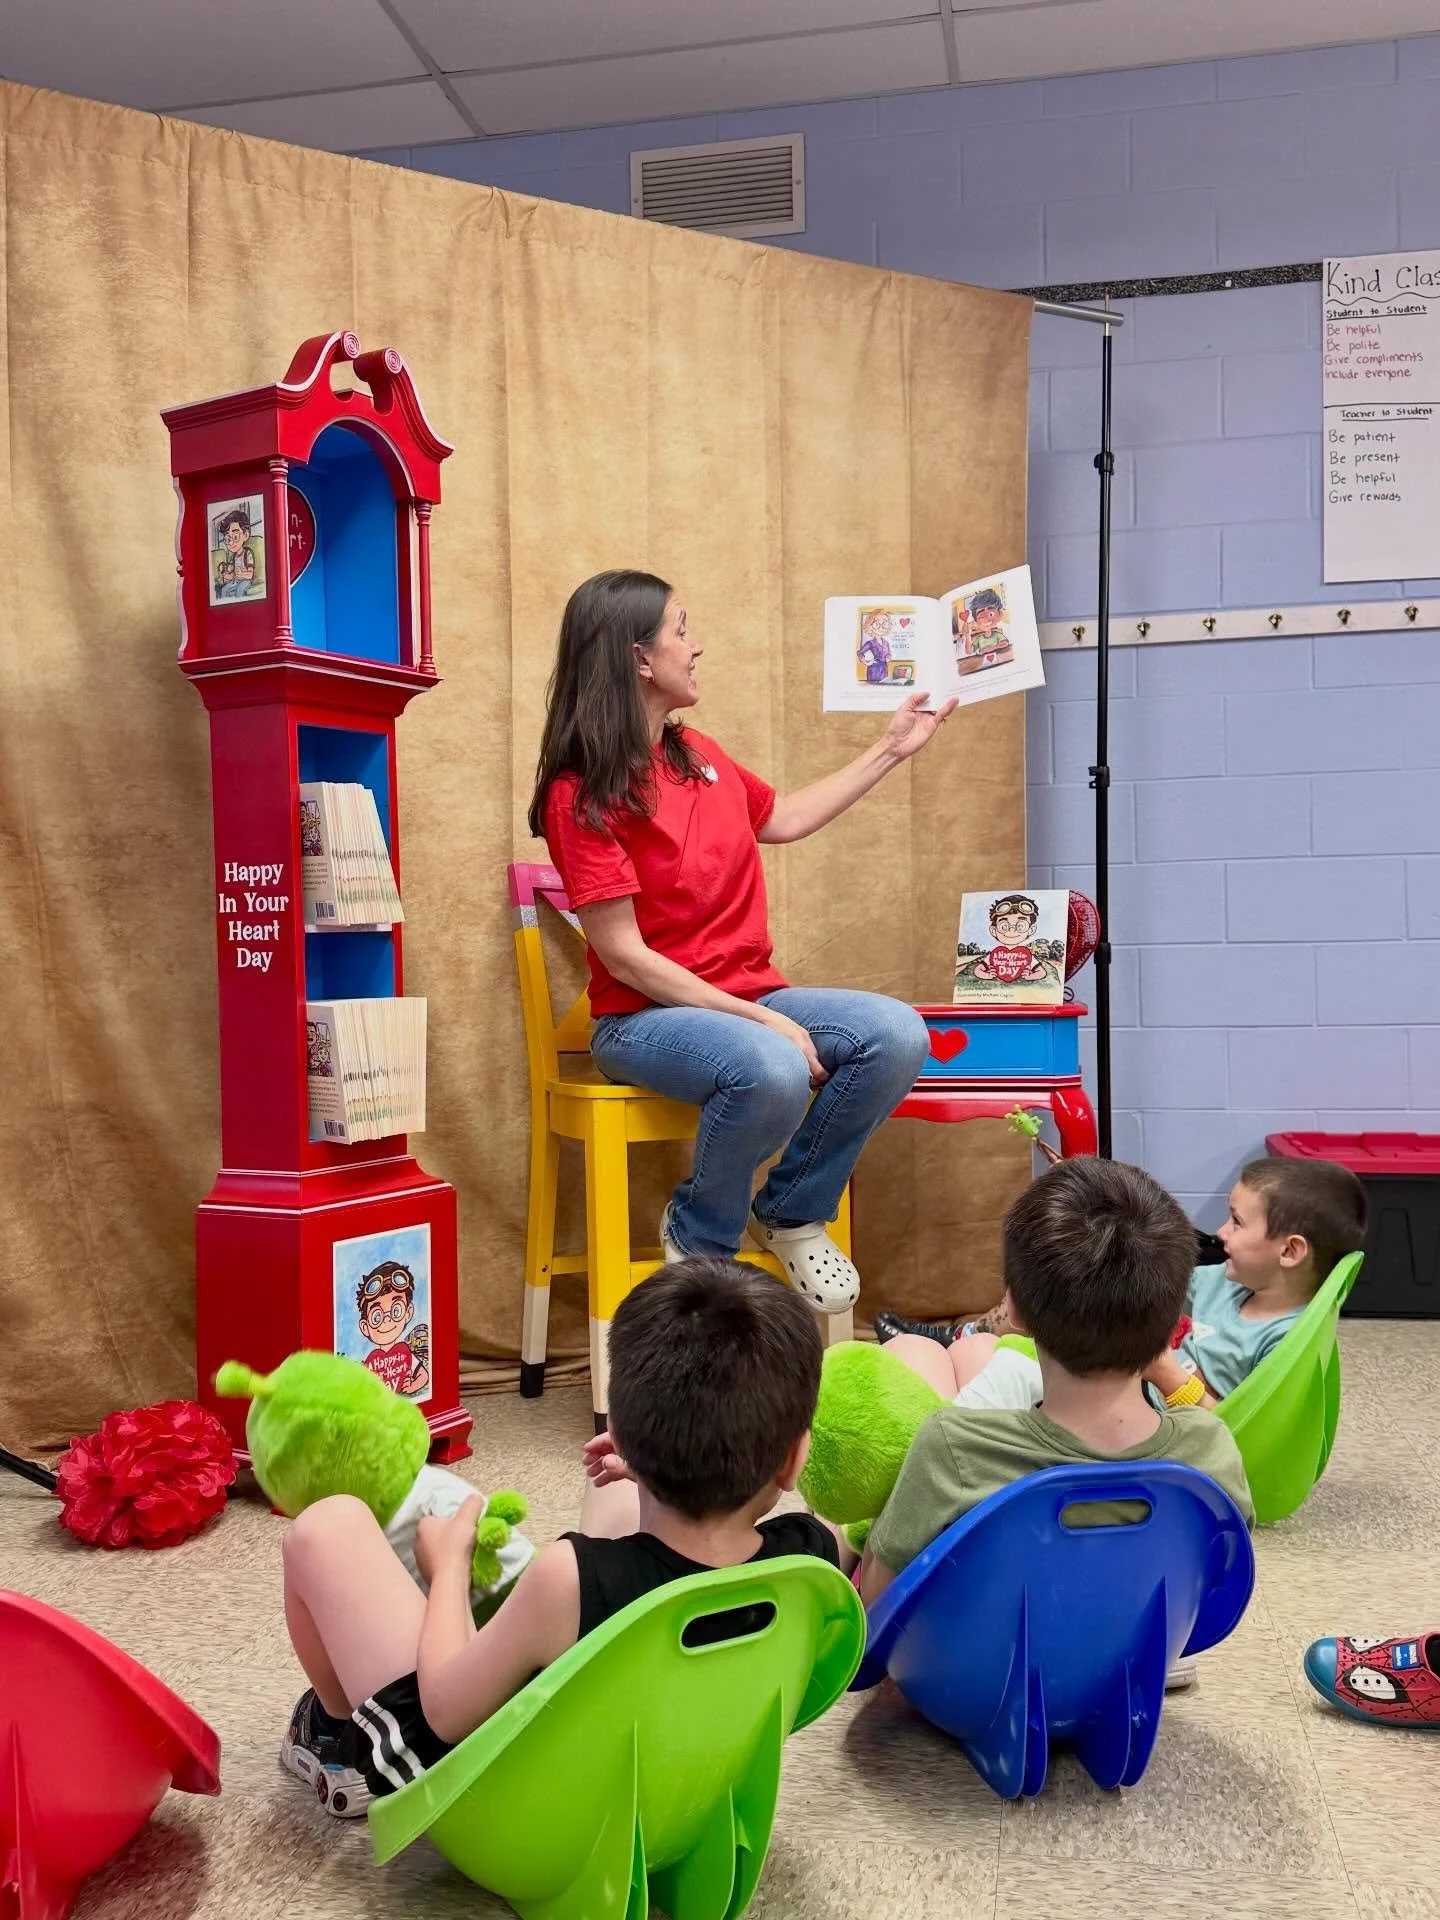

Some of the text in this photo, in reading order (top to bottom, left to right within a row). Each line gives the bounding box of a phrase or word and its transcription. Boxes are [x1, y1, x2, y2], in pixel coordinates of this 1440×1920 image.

[1327, 261, 1381, 297] Kind
[1326, 304, 1427, 318] Student to Student
[1326, 323, 1381, 336] Be helpful
[1326, 338, 1380, 354] Be polite
[1325, 352, 1424, 366] Give compliments
[1365, 368, 1412, 381] everyone
[1341, 406, 1433, 418] Teacher to Student
[1328, 428, 1397, 446] Be patient
[1330, 450, 1400, 467] Be present
[1330, 470, 1396, 486] Be helpful
[1328, 489, 1401, 504] Give rewards
[224, 862, 284, 887] Happy
[219, 892, 289, 913] In Your
[228, 919, 280, 940] Heart
[236, 947, 274, 973] Day
[998, 965, 1021, 978] Day
